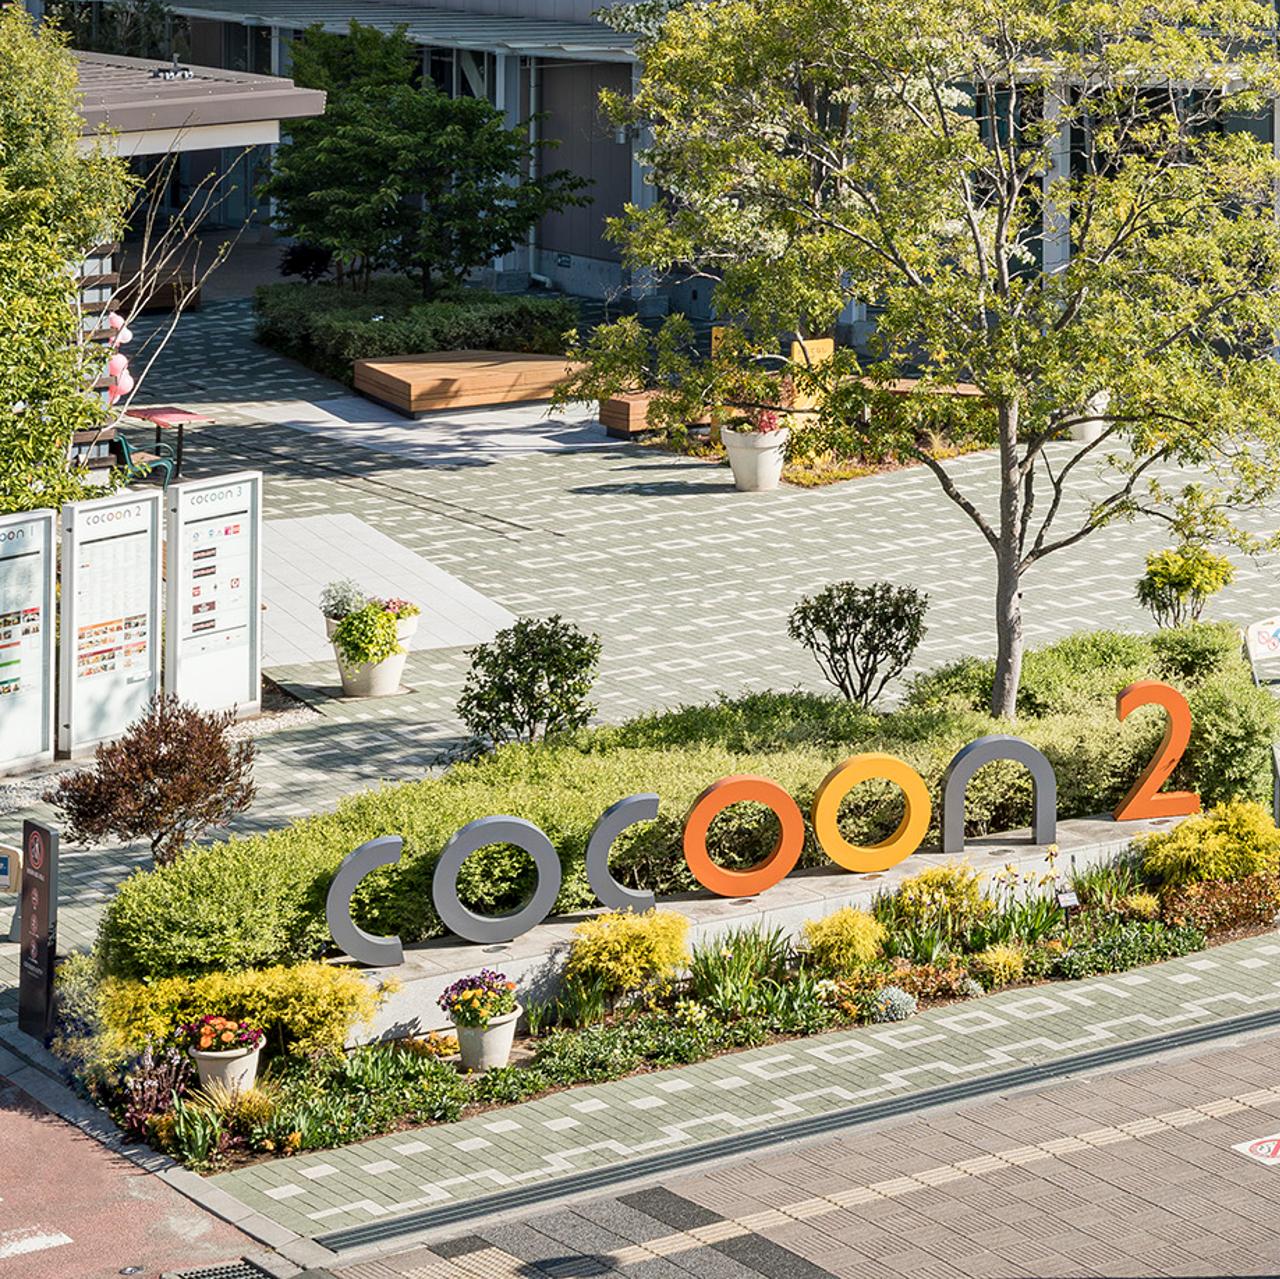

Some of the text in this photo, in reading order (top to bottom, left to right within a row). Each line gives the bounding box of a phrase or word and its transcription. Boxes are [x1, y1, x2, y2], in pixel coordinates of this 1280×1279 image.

[190, 486, 243, 506] cocoon 3
[85, 505, 142, 526] cocoon 2
[326, 680, 1202, 967] cocoon 2
